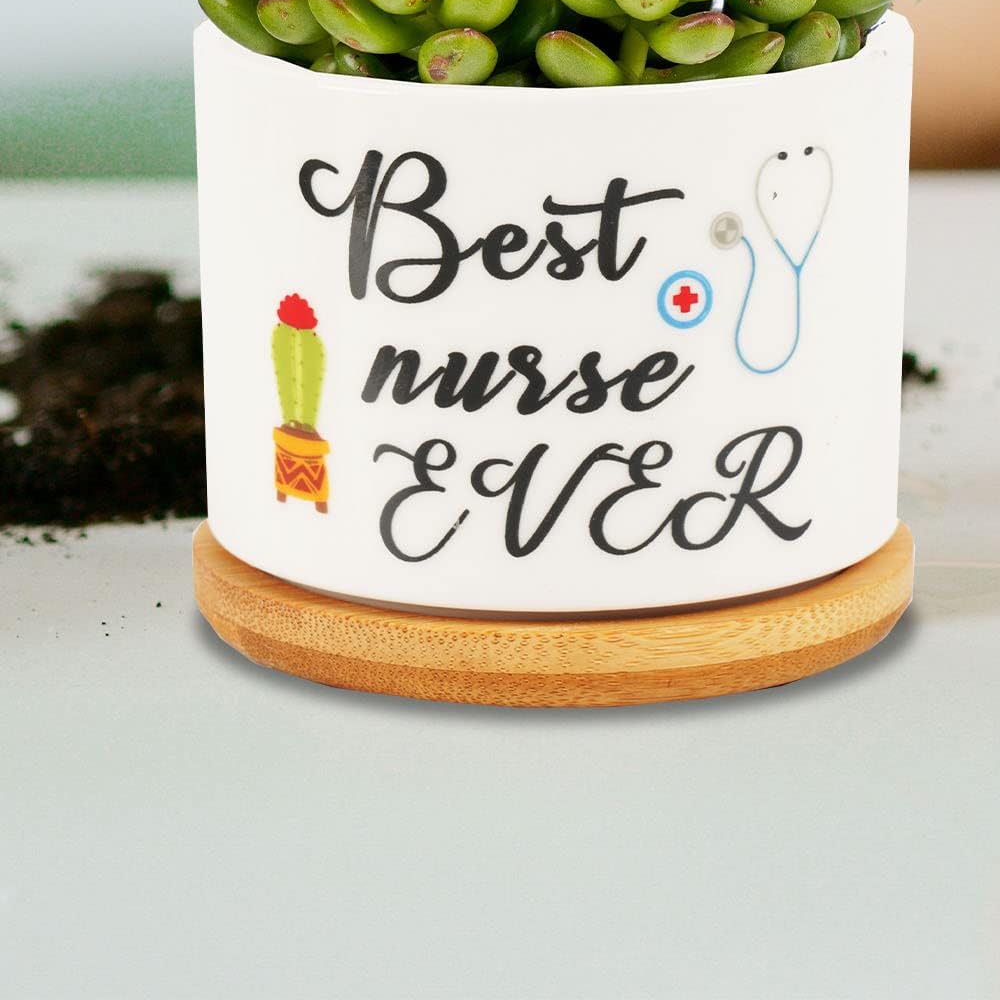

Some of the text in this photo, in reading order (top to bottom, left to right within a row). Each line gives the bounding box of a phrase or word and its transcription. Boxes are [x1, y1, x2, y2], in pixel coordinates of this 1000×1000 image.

[299, 150, 684, 304] Best
[362, 345, 695, 415] nurse
[374, 426, 812, 562] EVER
